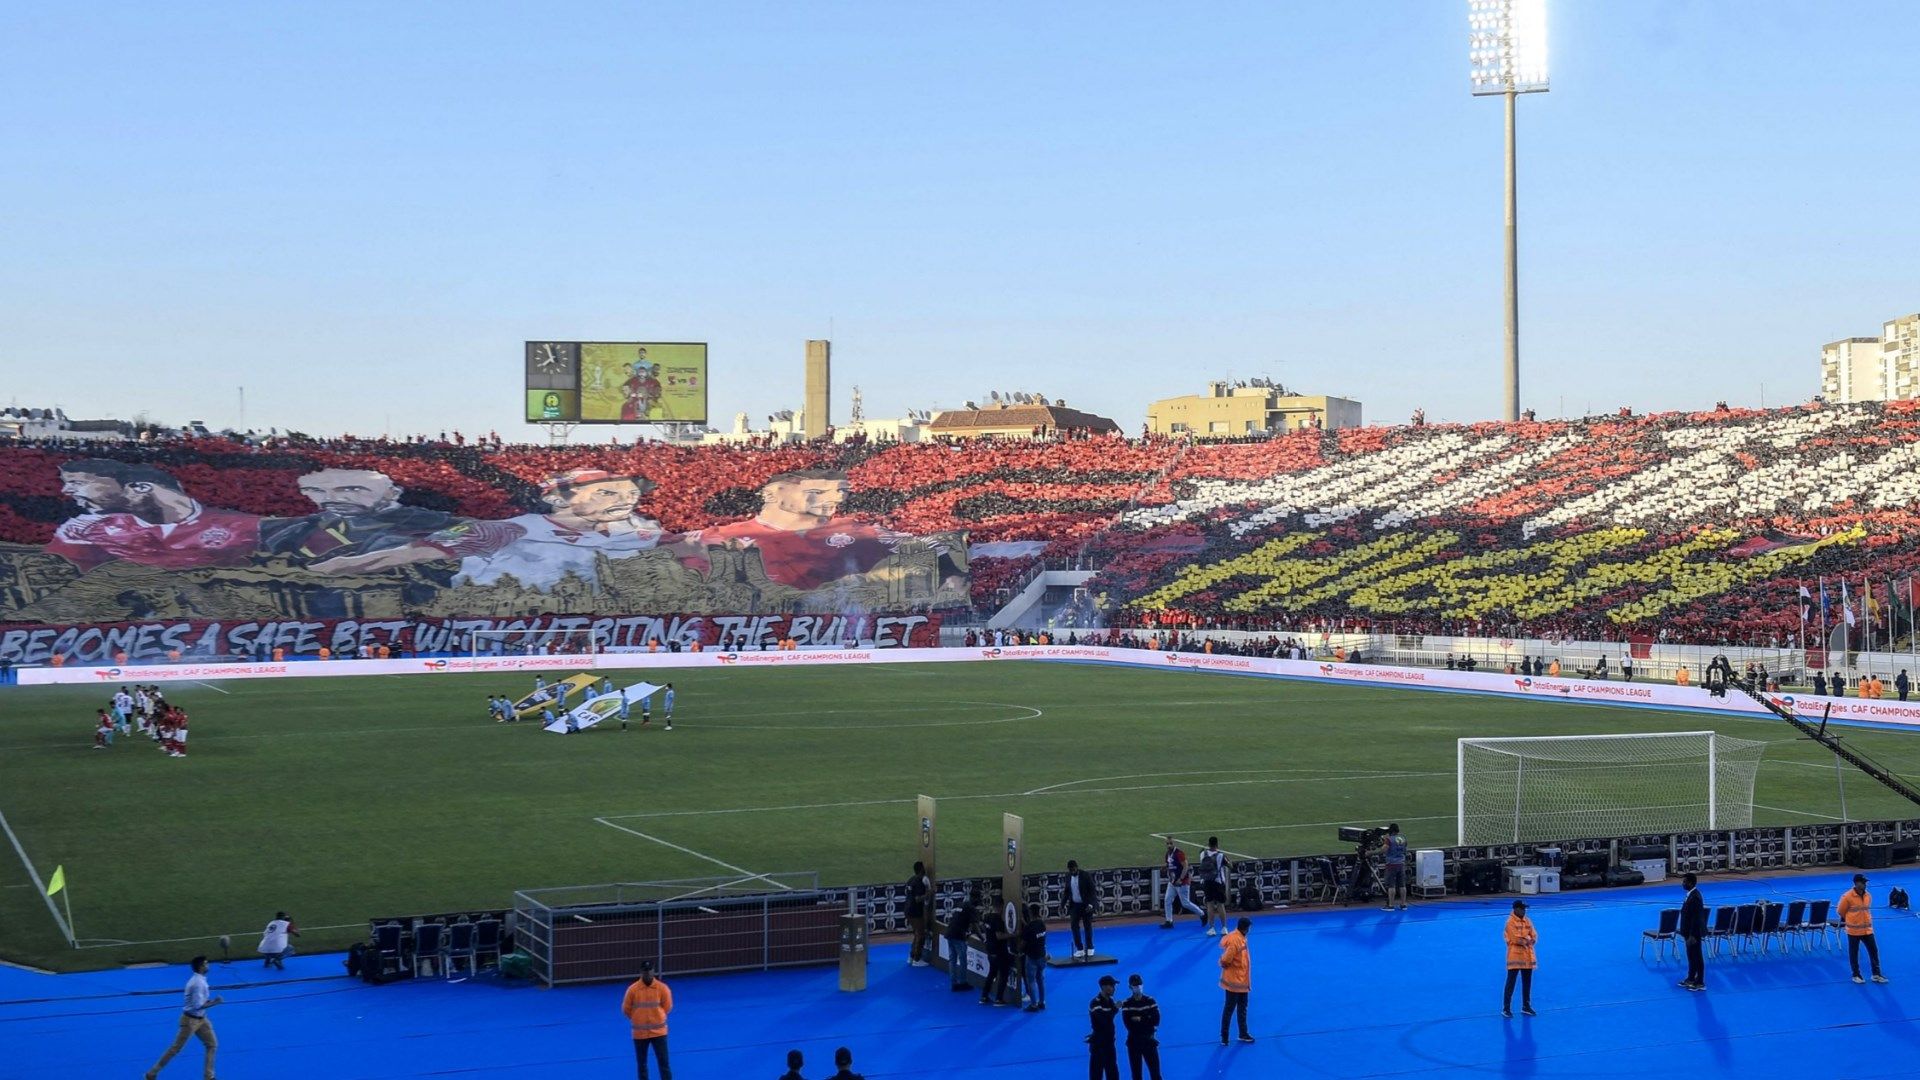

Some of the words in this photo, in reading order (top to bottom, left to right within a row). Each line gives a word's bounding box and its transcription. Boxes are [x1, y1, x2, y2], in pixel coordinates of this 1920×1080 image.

[1, 623, 192, 663] BECOMES
[194, 622, 222, 656] A
[227, 620, 326, 656] SAFE
[331, 620, 413, 654] BET
[591, 616, 703, 648] BITING
[713, 616, 784, 648] THE
[786, 615, 929, 648] BULLET
[740, 655, 784, 663] TotalEnergies
[449, 661, 498, 669] TotalEergies
[202, 667, 251, 675] CHAMPIONS
[1375, 670, 1404, 679] CHAMPIONS
[1573, 684, 1585, 692] CAF
[1586, 685, 1625, 696] CHAMPIONS
[1625, 688, 1652, 698] LEAGUE
[1796, 700, 1848, 713] TotalEnegies
[1851, 704, 1868, 713] CAF
[1870, 706, 1920, 718] CHAMPIONS
[577, 711, 599, 722] CAF
